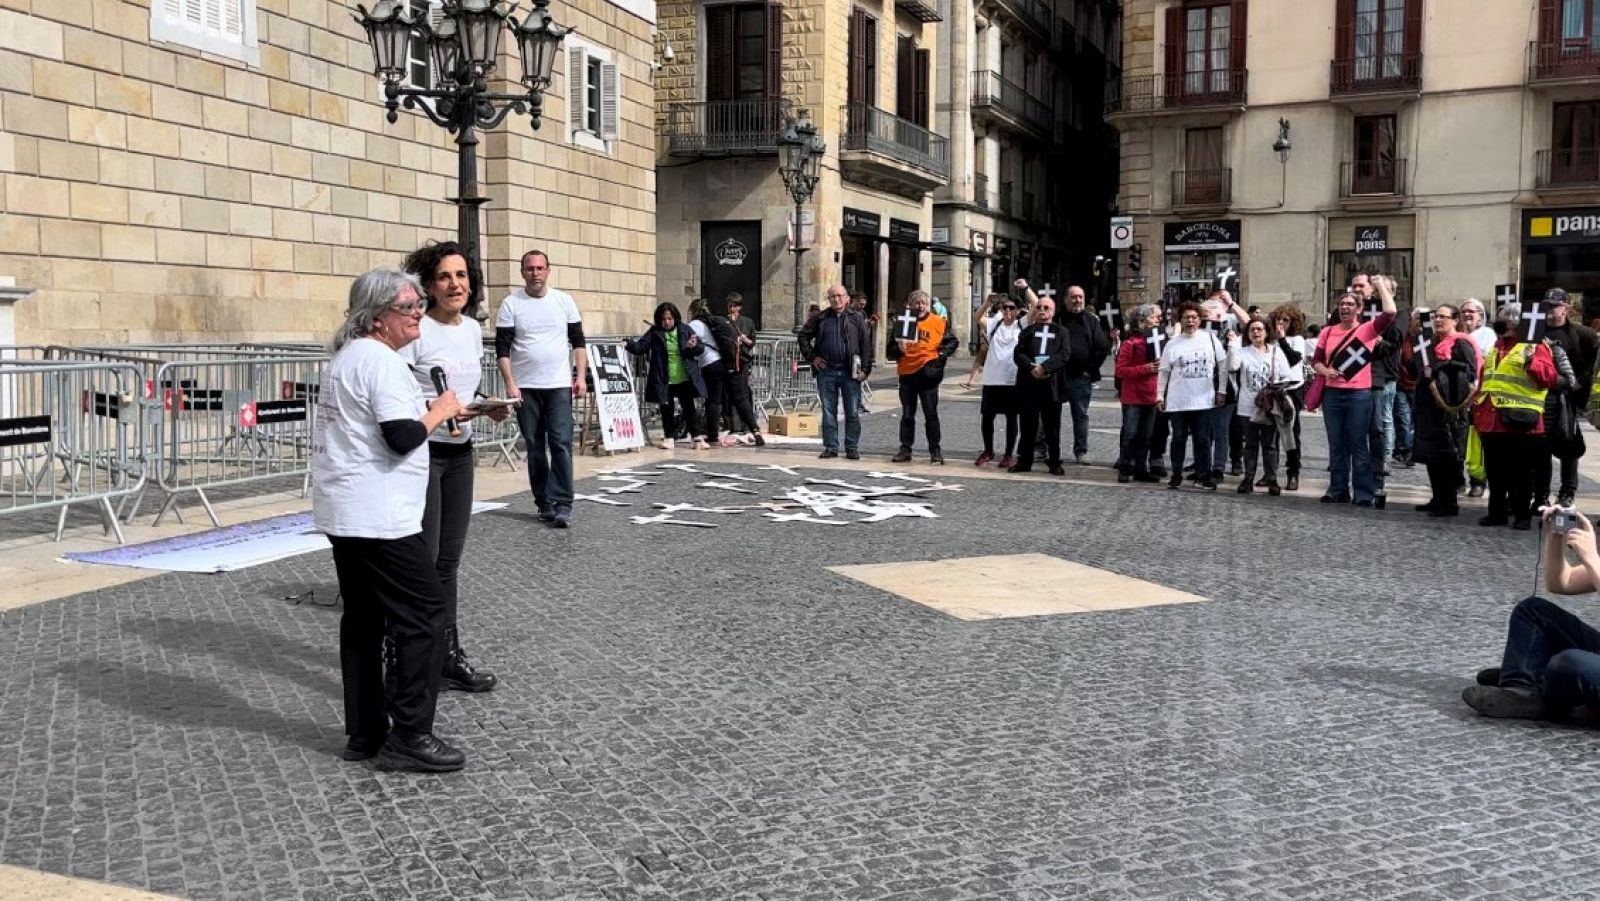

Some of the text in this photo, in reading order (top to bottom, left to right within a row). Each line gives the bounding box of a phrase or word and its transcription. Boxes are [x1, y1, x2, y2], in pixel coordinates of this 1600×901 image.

[1174, 223, 1231, 241] BARCELONA
[1555, 215, 1600, 236] pan
[1356, 241, 1386, 252] pans
